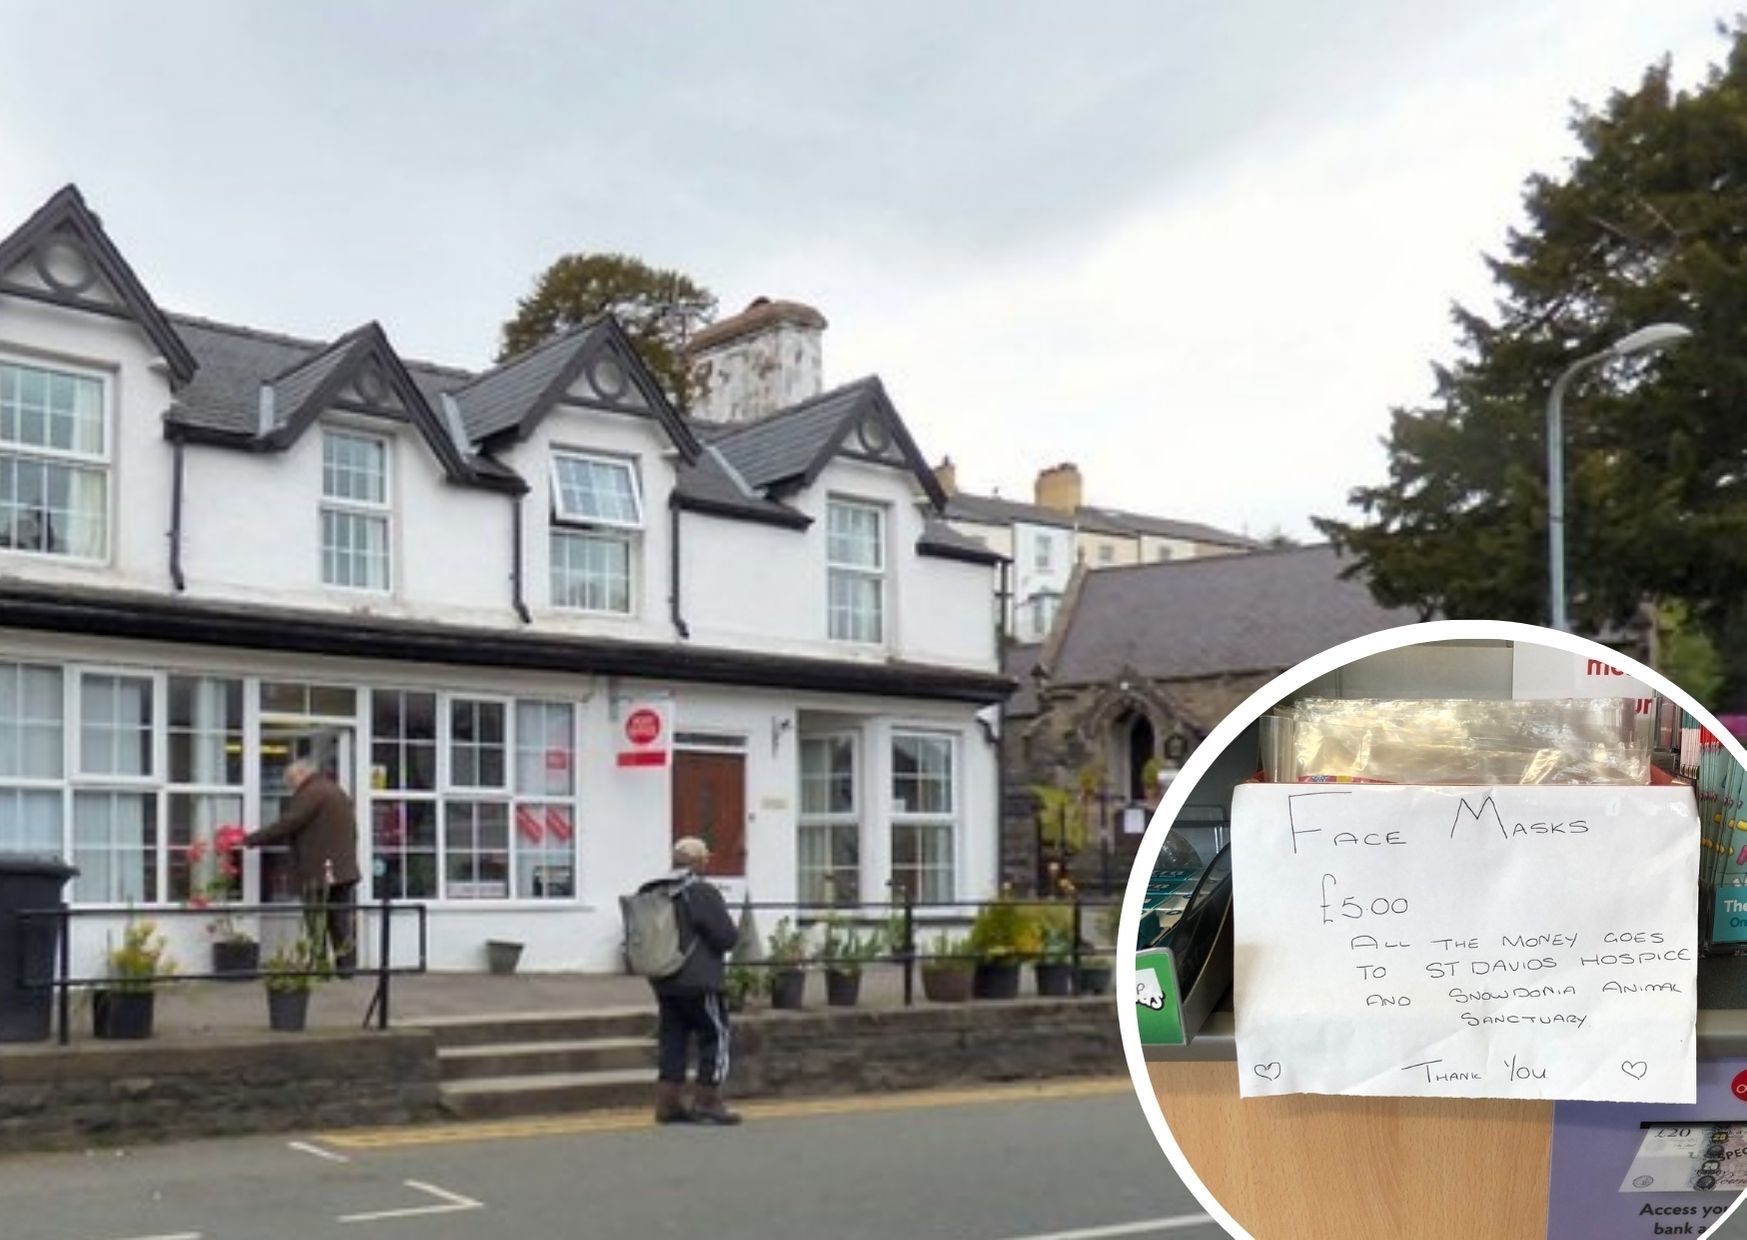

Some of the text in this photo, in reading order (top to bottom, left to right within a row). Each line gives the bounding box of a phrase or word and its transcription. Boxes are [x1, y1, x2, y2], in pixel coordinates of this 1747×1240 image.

[1430, 937, 1479, 952] THE
[1502, 932, 1578, 949] MONEY
[1603, 931, 1665, 944] GOES
[1355, 964, 1387, 981] TO
[1425, 960, 1460, 979] ST
[1580, 947, 1692, 967] HOSPICE
[1460, 1011, 1588, 1029] SANCTUARY
[1639, 1203, 1728, 1218] Access yo
[1653, 1222, 1693, 1235] bank
